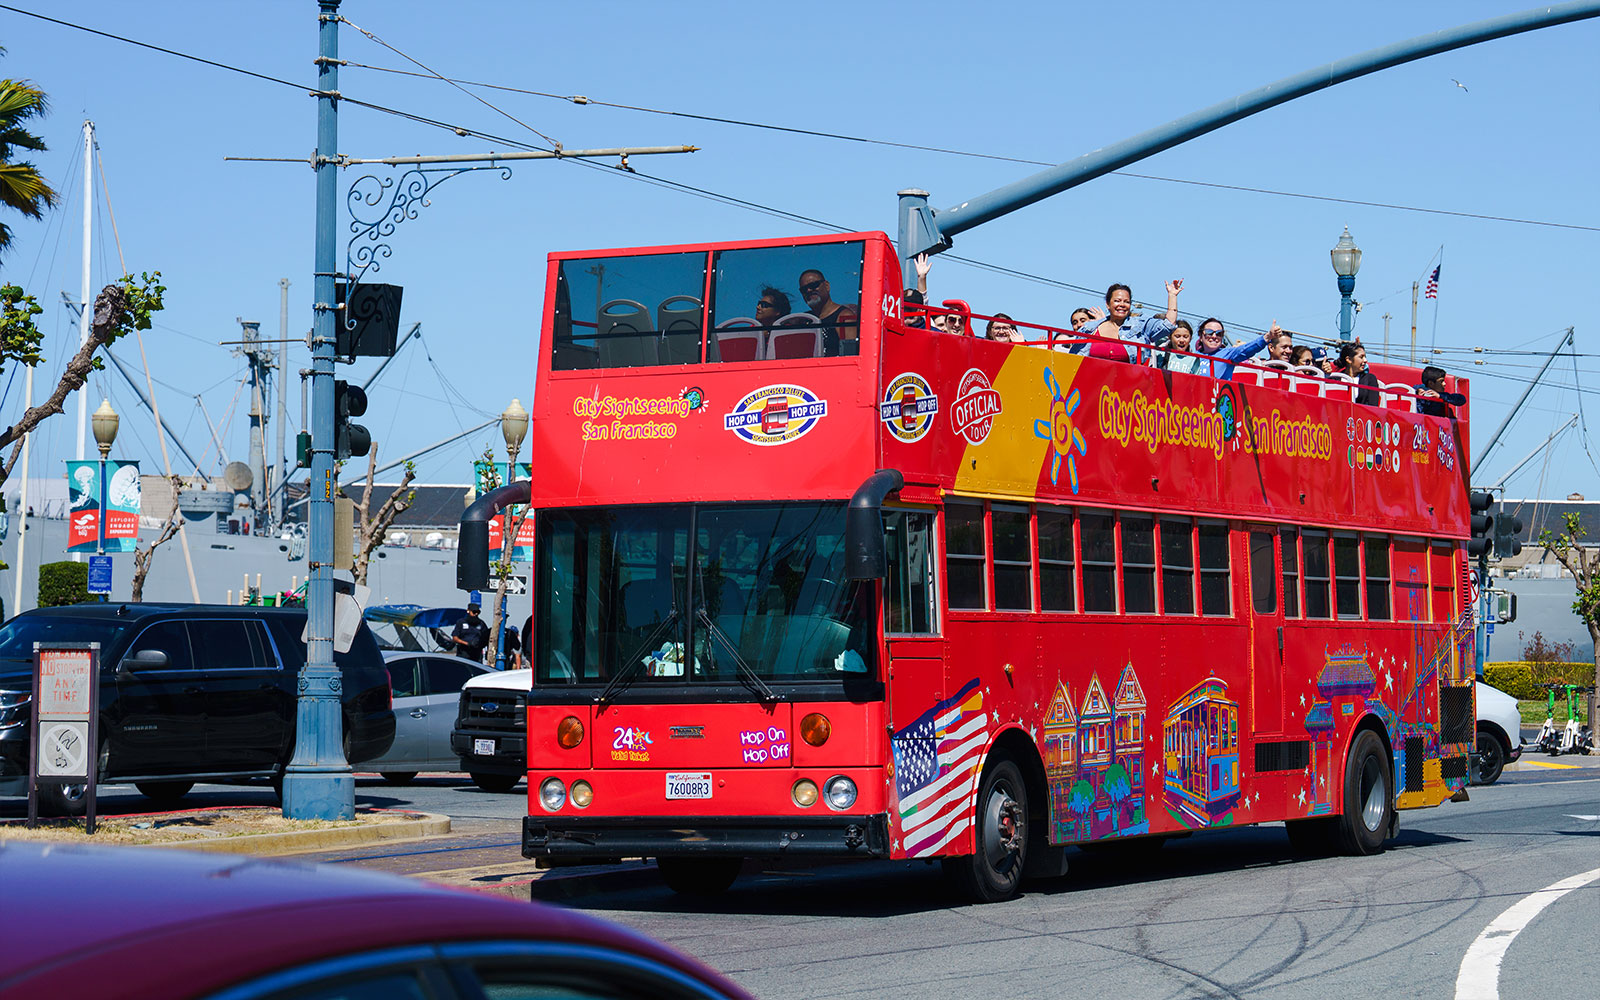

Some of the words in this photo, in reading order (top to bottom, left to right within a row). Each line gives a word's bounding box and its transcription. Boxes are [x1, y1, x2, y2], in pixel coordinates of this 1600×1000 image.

[882, 293, 901, 319] 421
[744, 395, 756, 407] SAN
[755, 387, 784, 400] FRANCISCO
[785, 387, 806, 398] DELUXE
[917, 400, 927, 412] HOP
[927, 399, 936, 411] OFF
[728, 416, 745, 427] HOP
[746, 414, 758, 424] ON
[791, 407, 808, 418] HOP
[809, 404, 824, 415] OFF
[882, 406, 892, 418] HOP
[892, 404, 900, 416] ON
[956, 394, 1000, 427] OFFICIAL
[582, 421, 608, 440] San
[611, 420, 677, 440] Francisco
[970, 419, 990, 440] TOUR
[1243, 405, 1270, 454] San
[1271, 408, 1332, 460] Francisco
[1413, 423, 1422, 450] 24
[41, 660, 55, 674] NO
[53, 690, 78, 702] TIME
[613, 726, 633, 749] 24
[740, 730, 766, 746] Hop
[767, 725, 786, 742] On
[743, 748, 768, 764] Hop
[770, 742, 790, 760] Off
[668, 782, 709, 795] 76008R3
